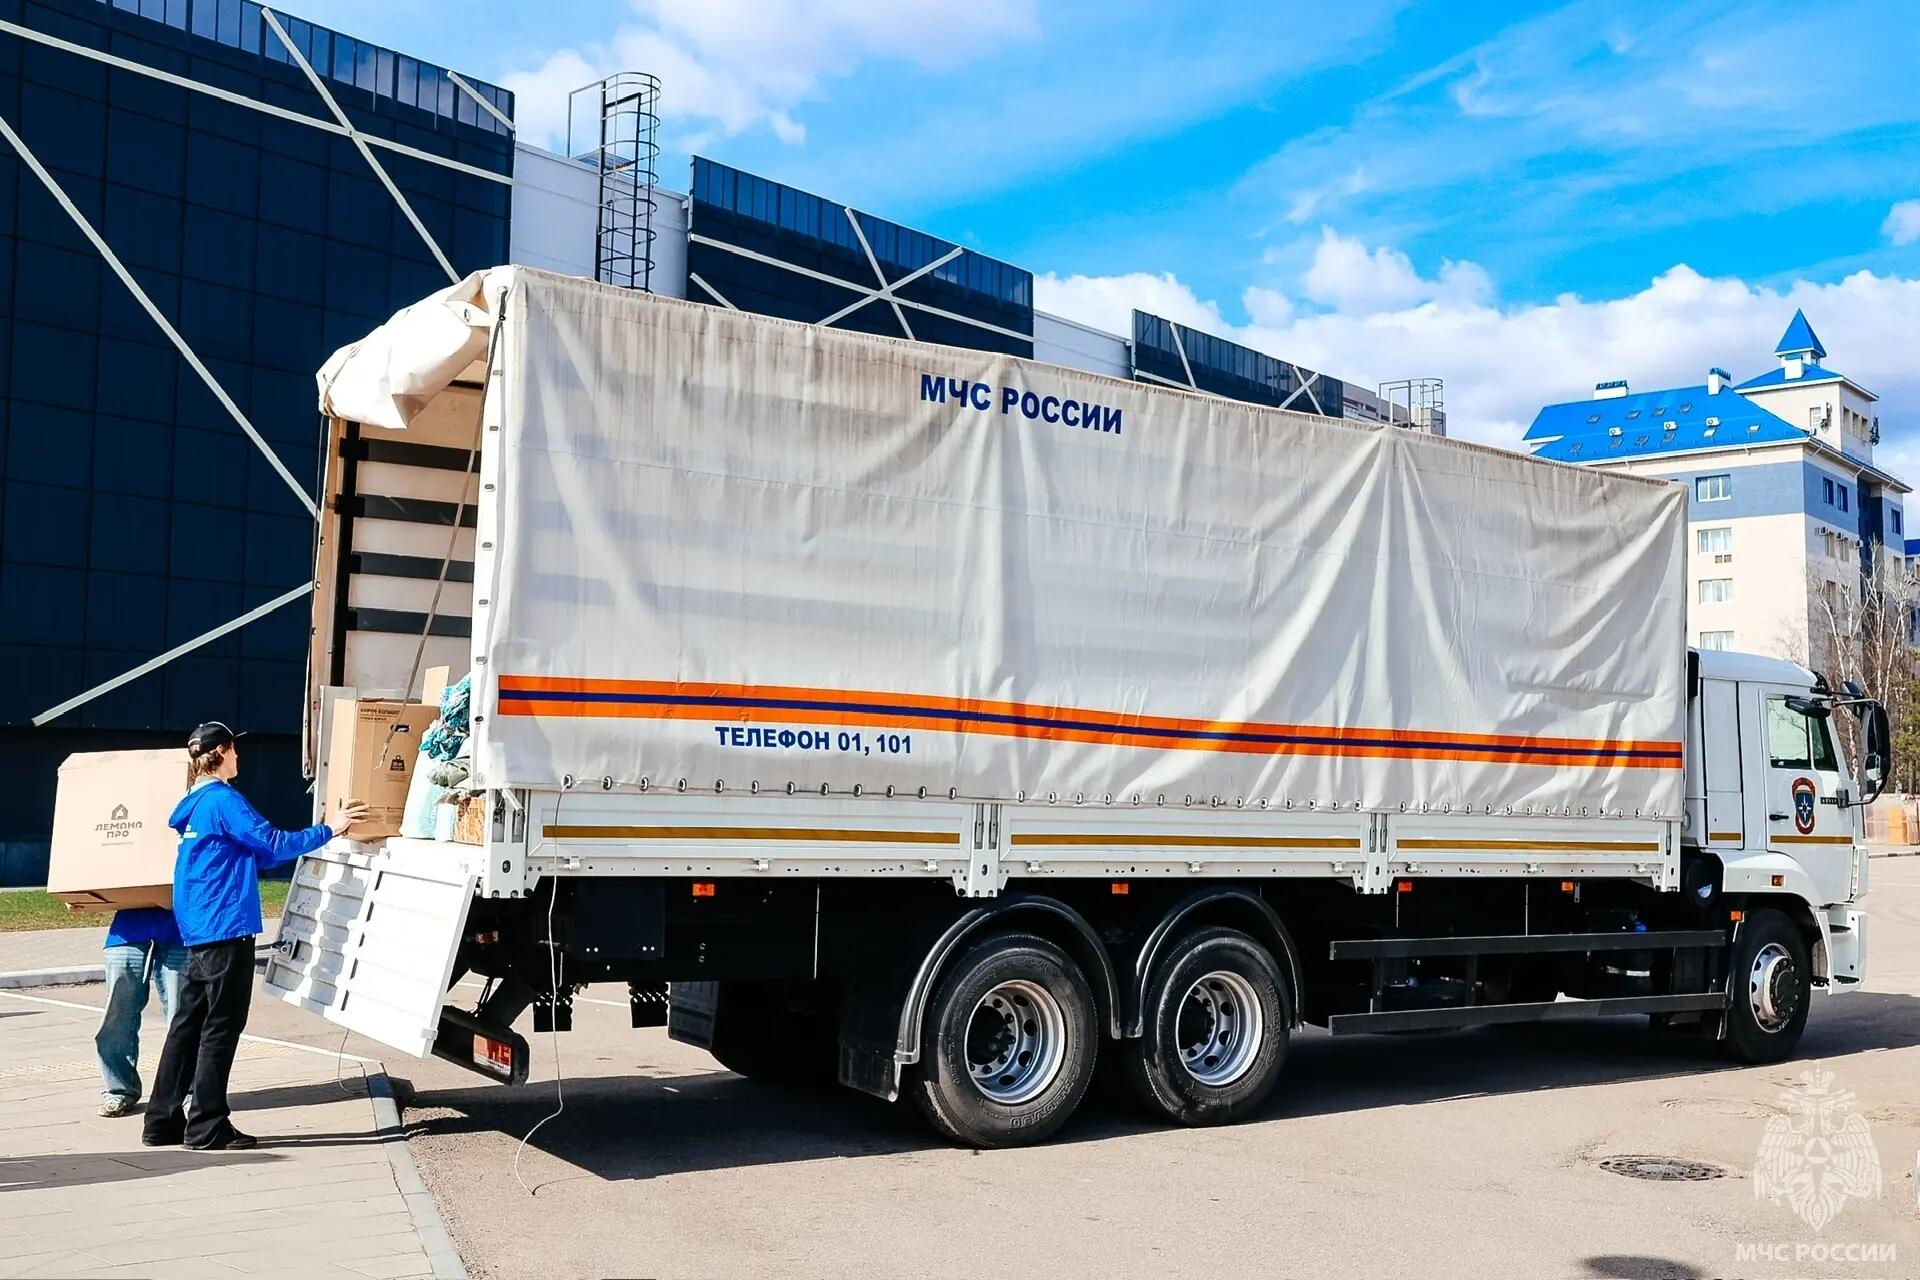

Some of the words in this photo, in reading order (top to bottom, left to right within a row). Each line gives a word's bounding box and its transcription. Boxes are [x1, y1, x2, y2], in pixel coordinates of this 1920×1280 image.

[920, 374, 991, 411] МЧС
[1001, 386, 1122, 434] РОССИИ
[715, 727, 830, 750] ТЕЛЕФОН
[838, 732, 869, 756] 01,
[877, 734, 911, 754] 101
[94, 821, 143, 831] ЛЕМАНА
[106, 830, 130, 839] ПРО
